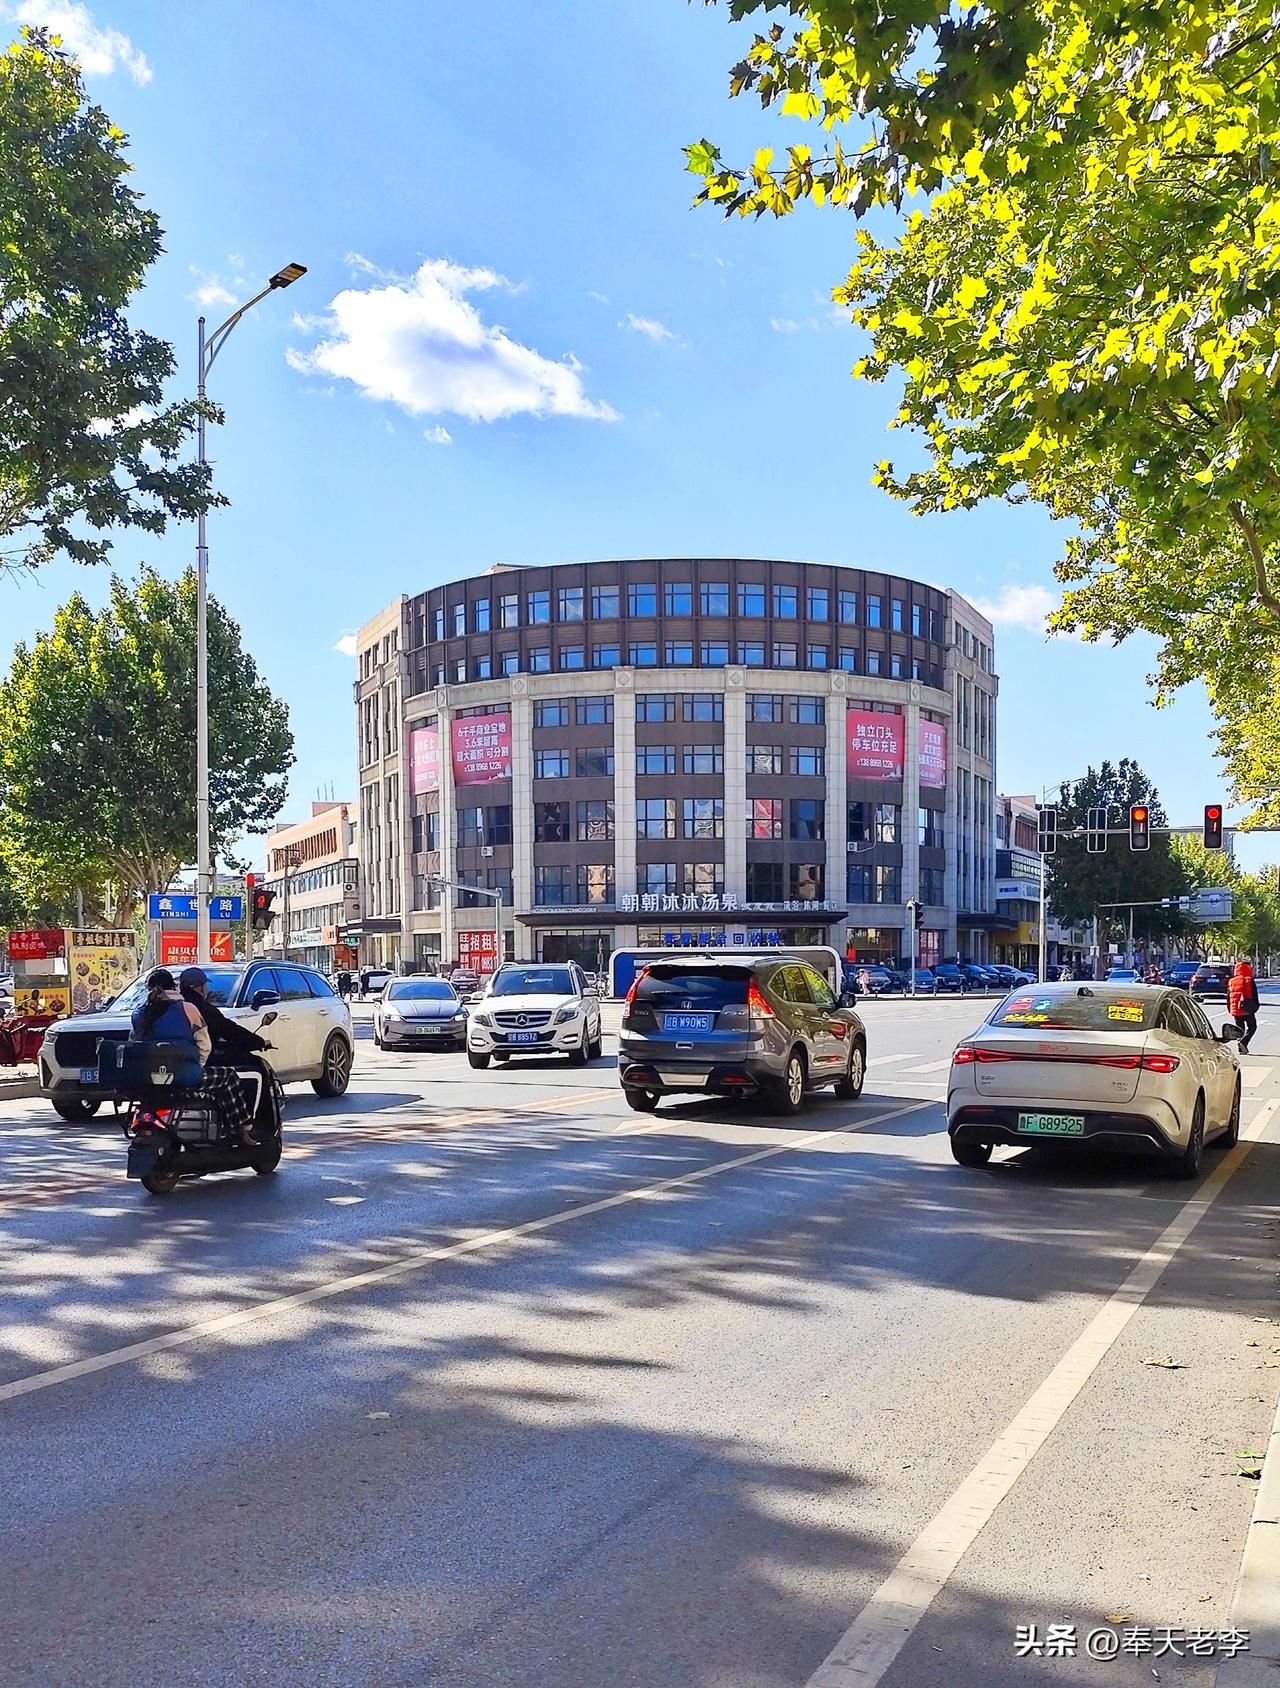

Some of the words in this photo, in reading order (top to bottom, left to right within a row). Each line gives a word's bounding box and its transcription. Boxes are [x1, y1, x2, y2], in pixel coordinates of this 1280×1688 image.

[457, 722, 506, 737] 6千平商业宝地
[857, 724, 893, 739] 独立门头
[852, 737, 897, 754] 停车位充足
[621, 892, 738, 912] 朝朝沐沐汤泉
